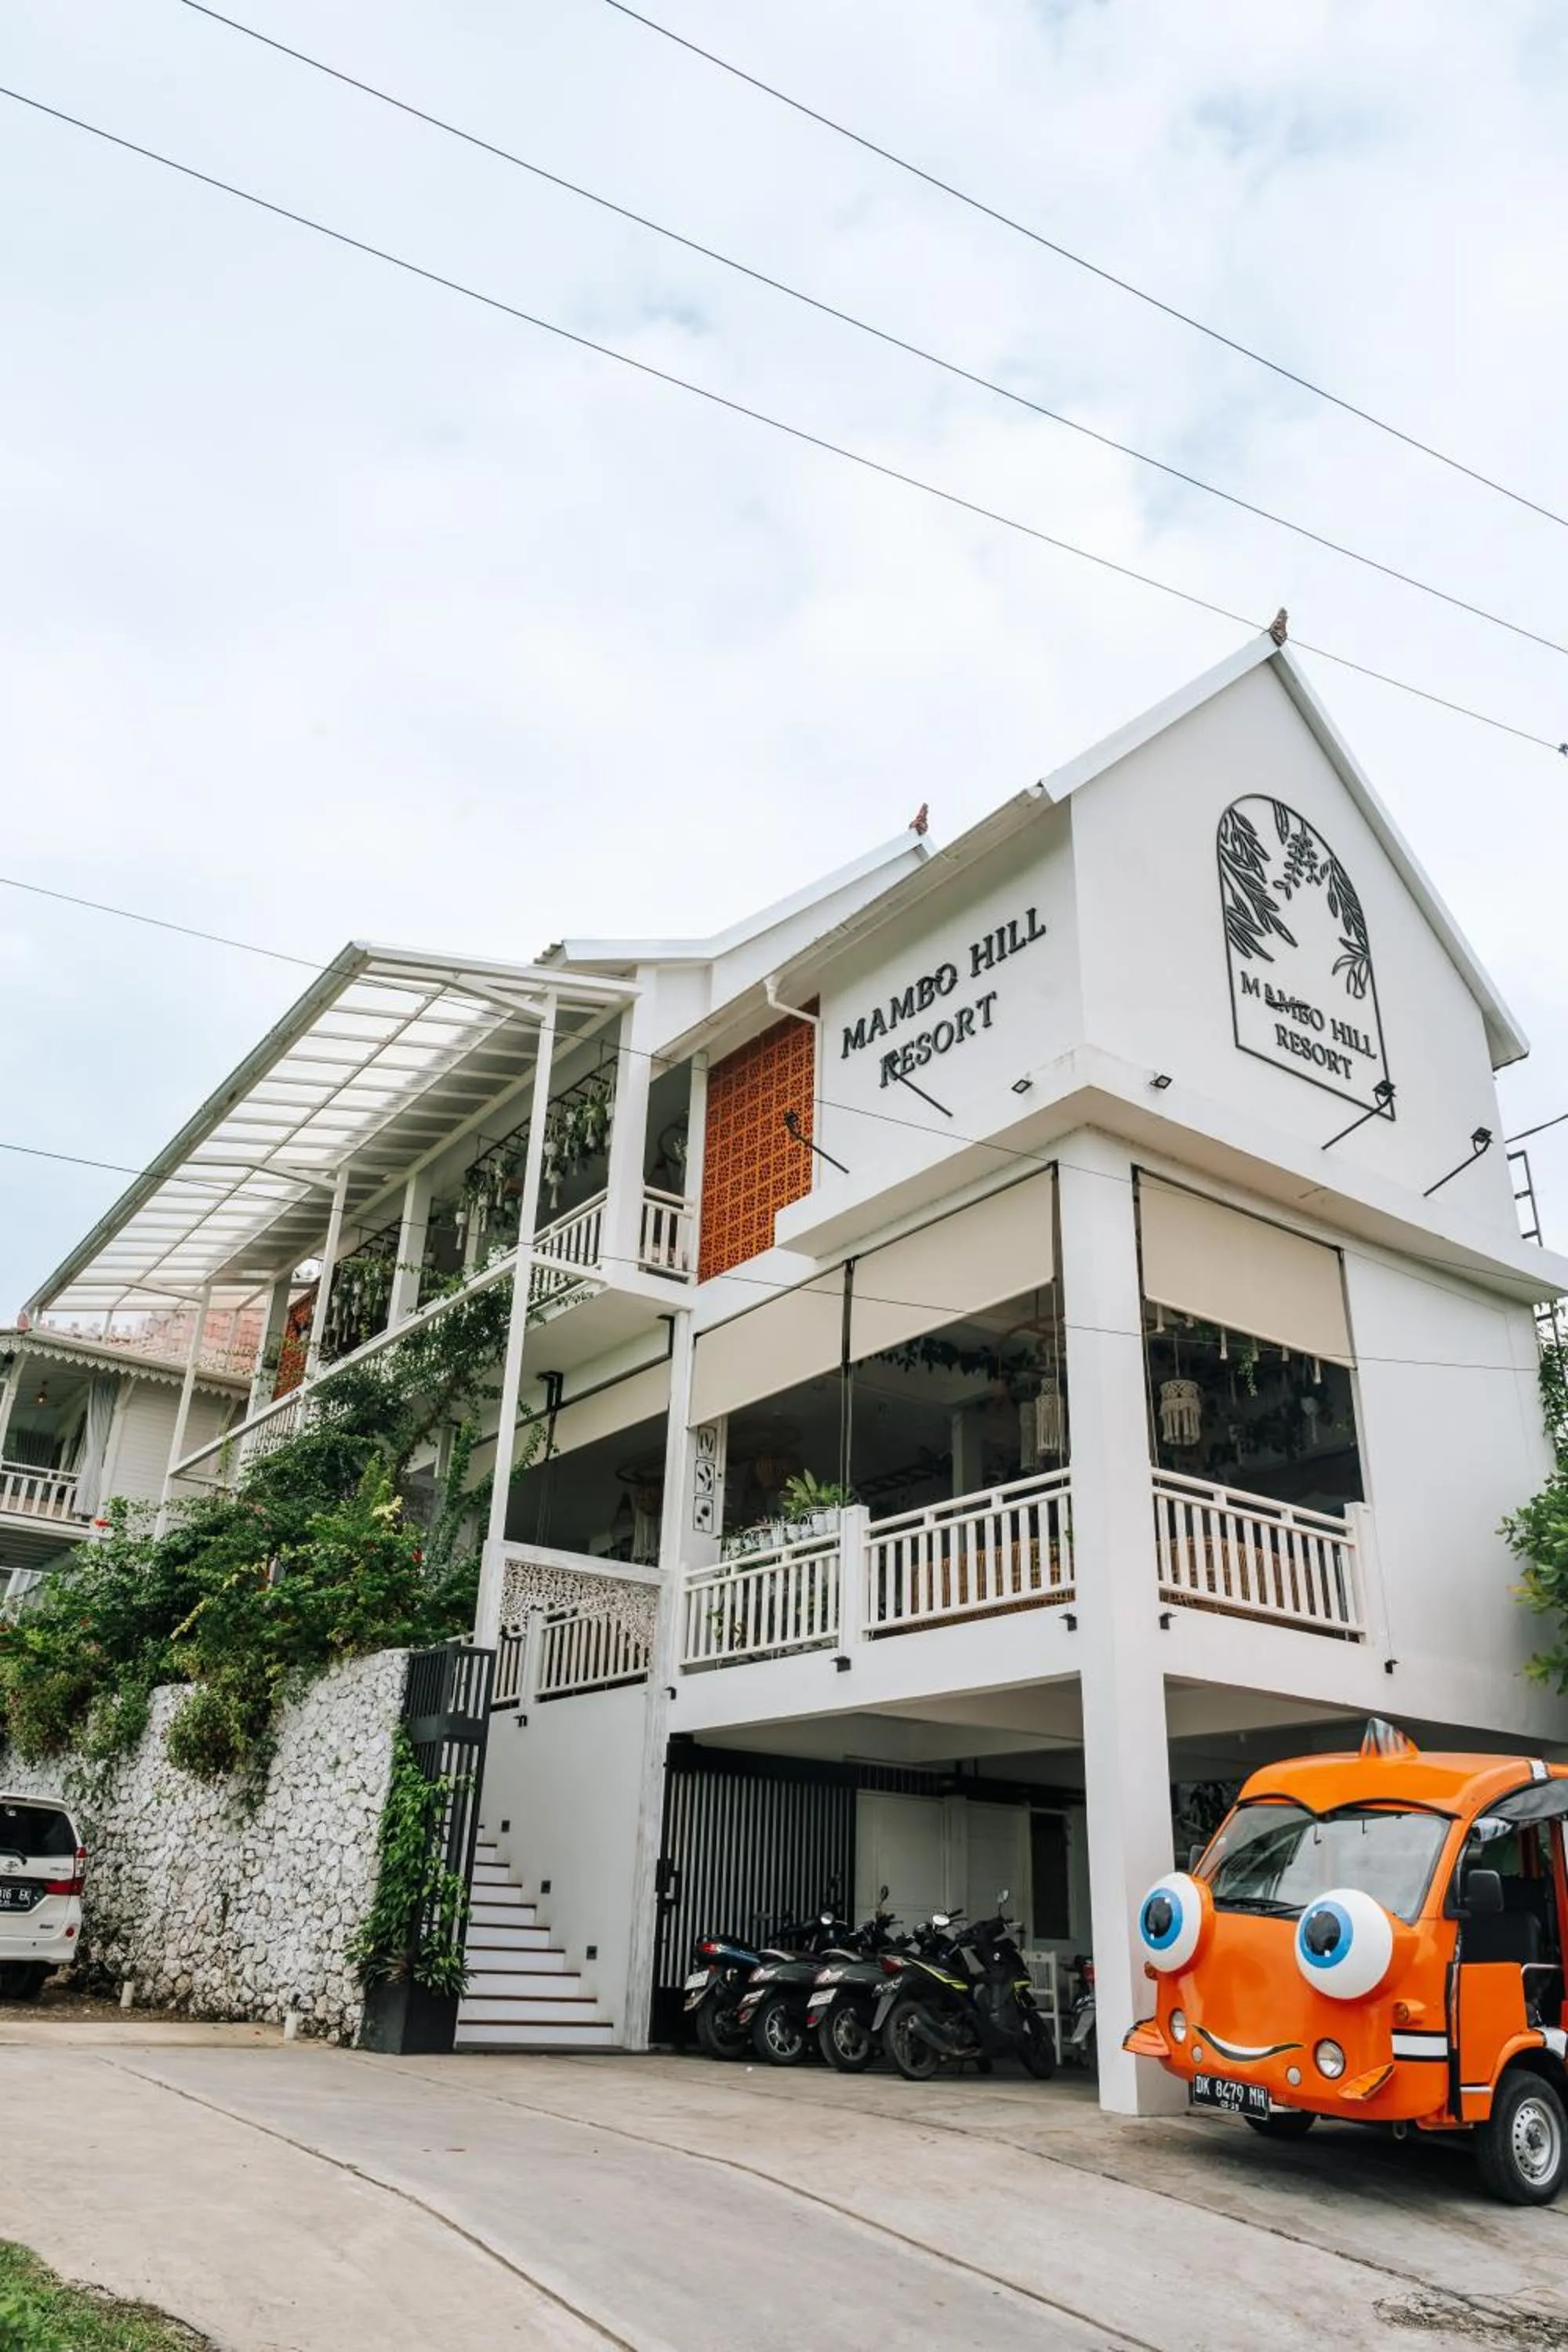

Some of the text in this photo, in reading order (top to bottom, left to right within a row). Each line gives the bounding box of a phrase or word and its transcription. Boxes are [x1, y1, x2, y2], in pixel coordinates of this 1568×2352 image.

[840, 907, 1047, 1059] MAMBO HILL
[1240, 971, 1377, 1060] MAMBO HILL
[878, 990, 998, 1089] RESORT
[1274, 1022, 1353, 1080] RESORT
[1196, 2075, 1210, 2096] DK
[1215, 2080, 1244, 2103] 8479
